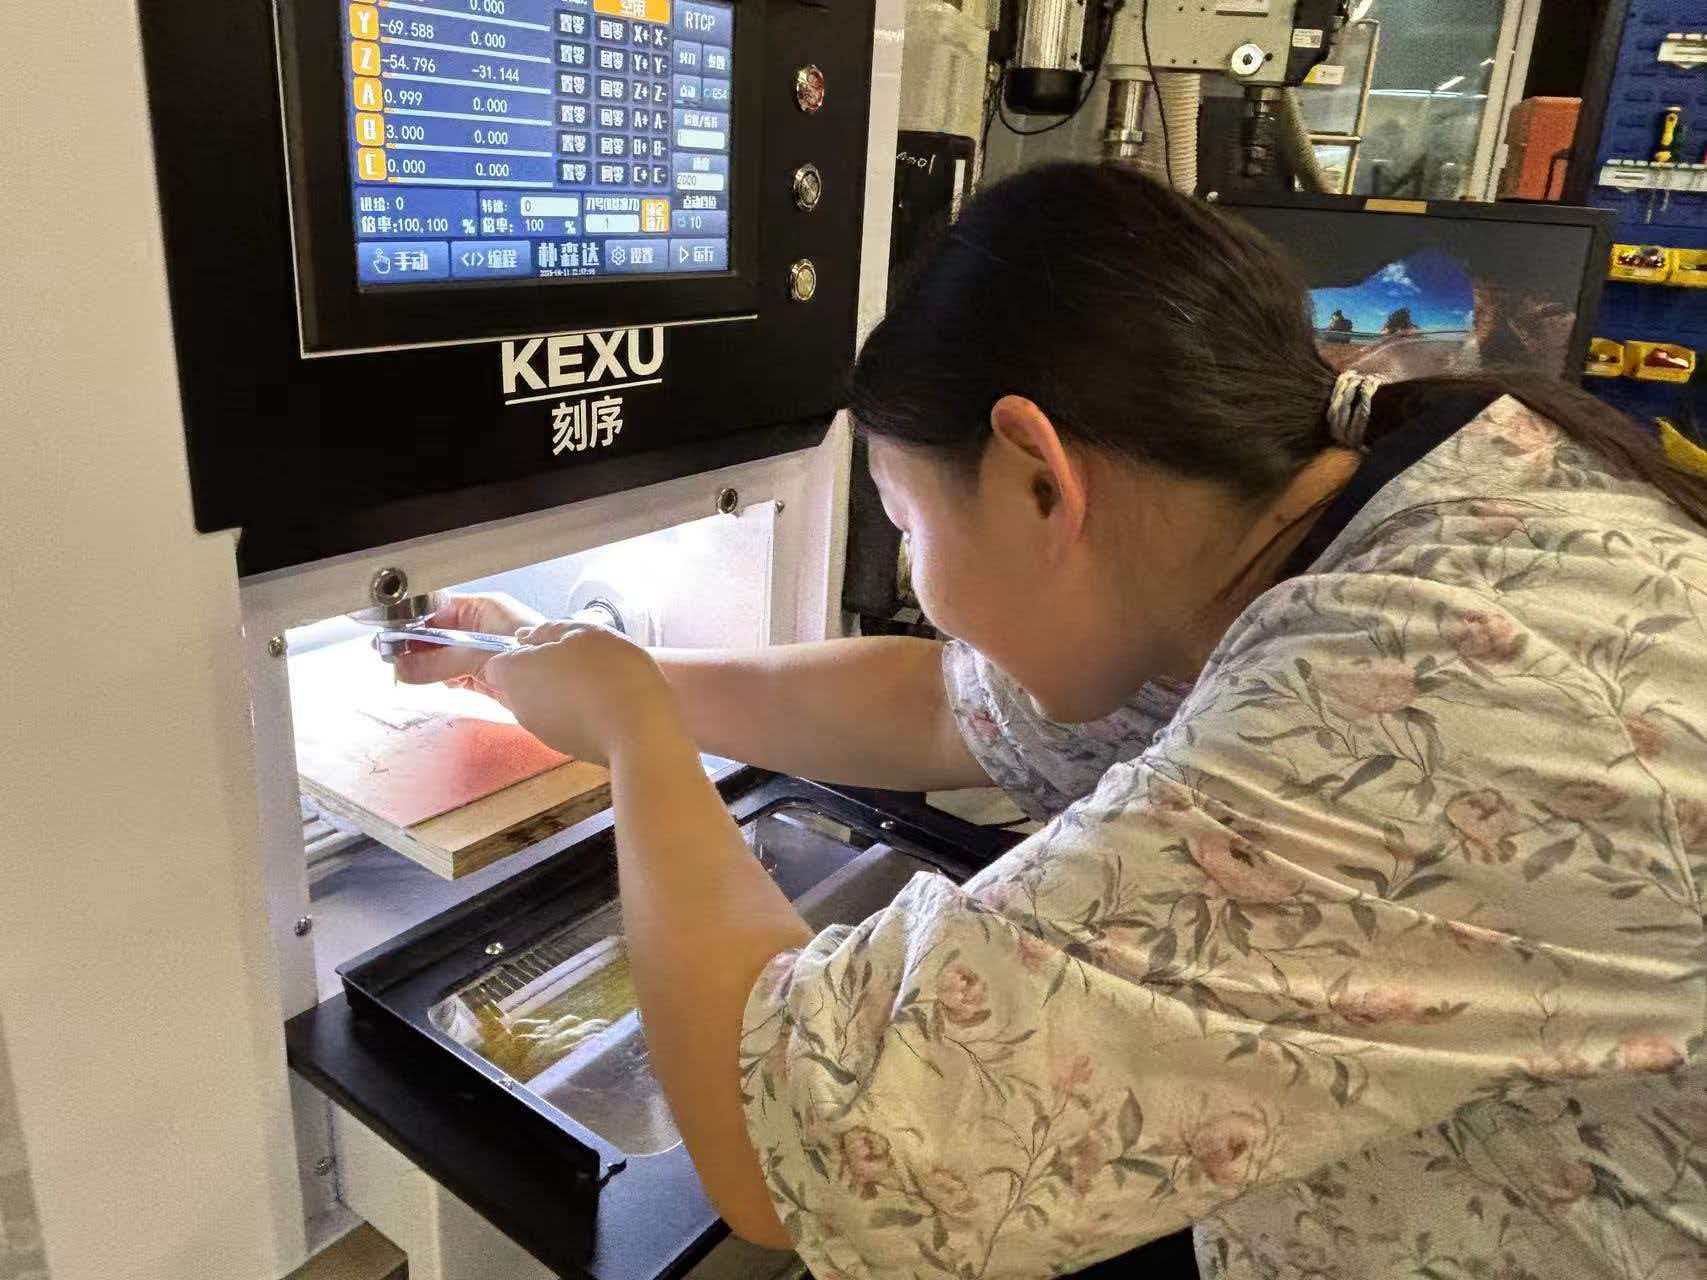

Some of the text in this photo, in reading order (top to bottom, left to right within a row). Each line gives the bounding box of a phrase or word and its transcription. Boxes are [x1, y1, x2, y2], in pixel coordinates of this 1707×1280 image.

[470, 0, 505, 14] 0.000
[359, 11, 505, 48] Y -69.588 0.000
[686, 11, 715, 31] RTCP
[360, 48, 519, 82] Z -54.796 -31.144
[362, 82, 507, 113] A 0.999 0.000
[386, 124, 424, 140] 3.000
[474, 130, 508, 145] 0.000
[388, 159, 425, 174] 0.000
[476, 163, 509, 177] 0.000
[395, 196, 404, 210] 0
[526, 219, 544, 232] 100
[691, 216, 702, 229] 10
[501, 326, 664, 394] KEXU
[552, 395, 623, 456] 刻序
